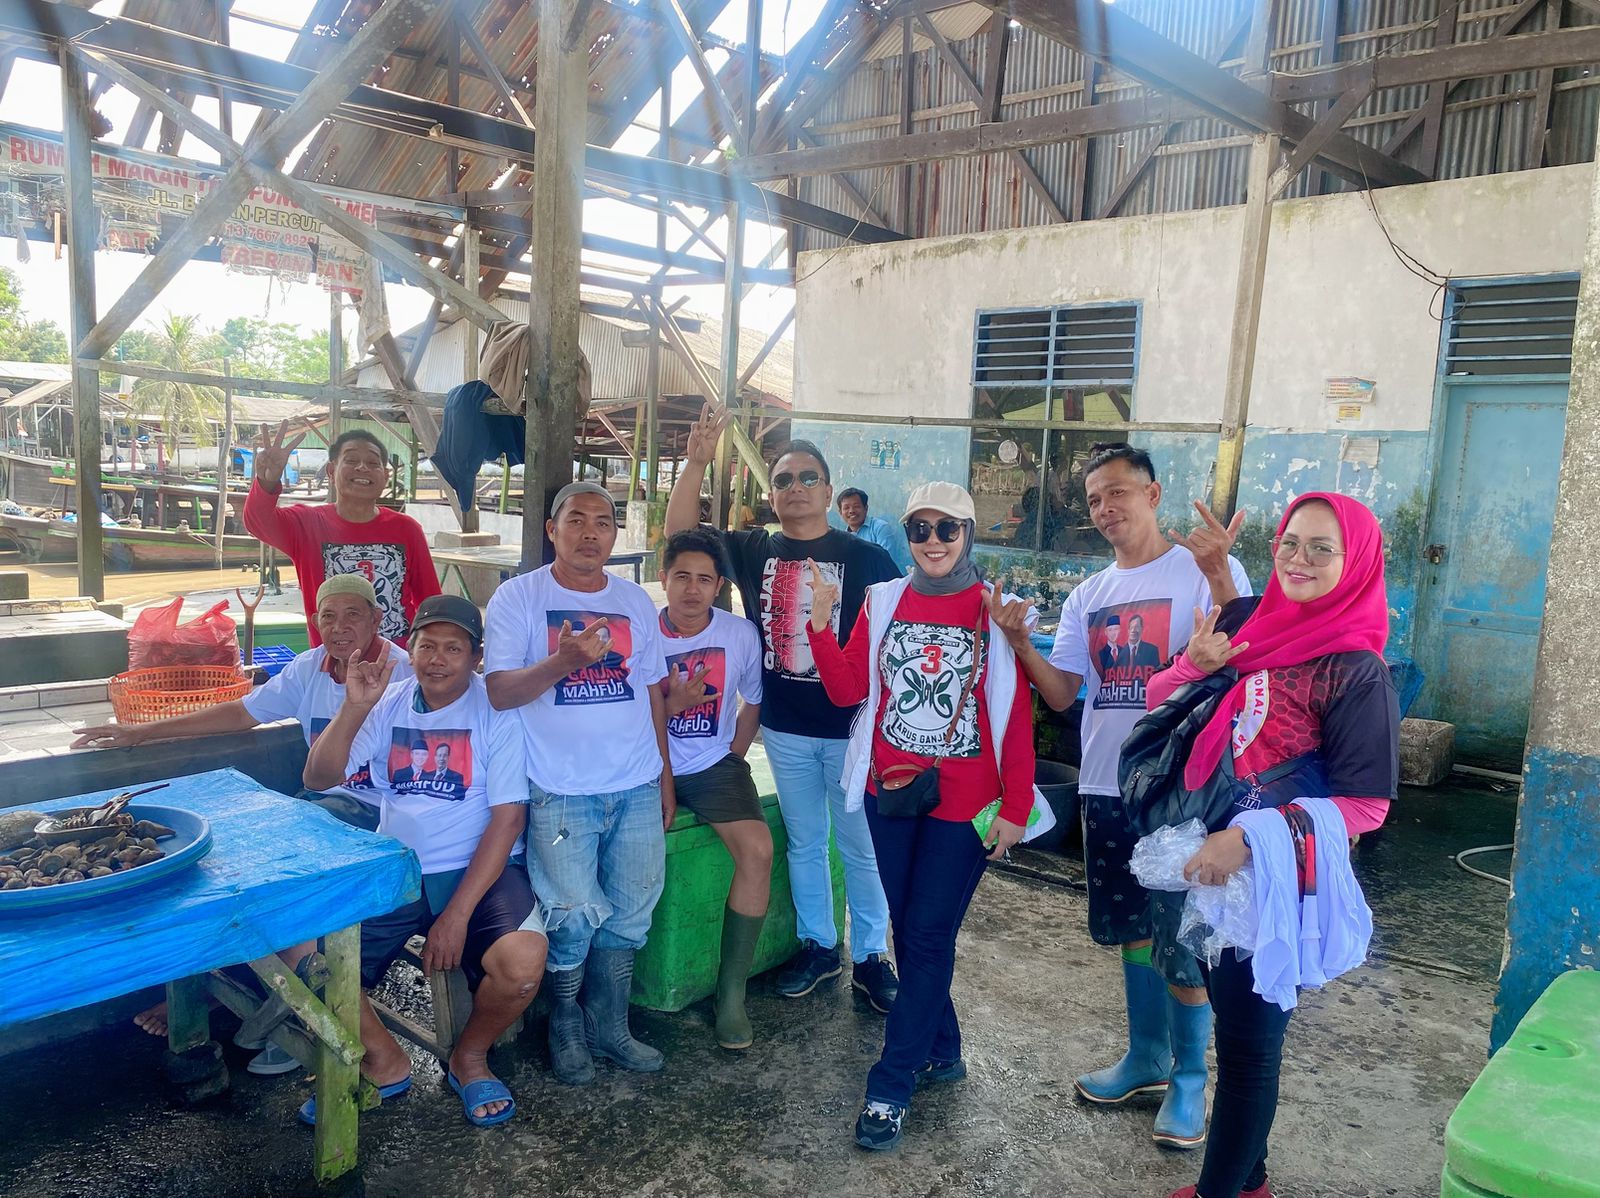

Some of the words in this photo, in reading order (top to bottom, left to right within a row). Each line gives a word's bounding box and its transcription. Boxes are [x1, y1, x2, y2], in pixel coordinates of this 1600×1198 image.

[10, 137, 99, 173] RUMH
[108, 159, 188, 189] MAKAN
[760, 557, 780, 671] GANJAR
[921, 644, 944, 674] 3
[563, 678, 625, 699] MAHFUD
[667, 713, 711, 733] AHFUD
[897, 722, 918, 741] ARUS
